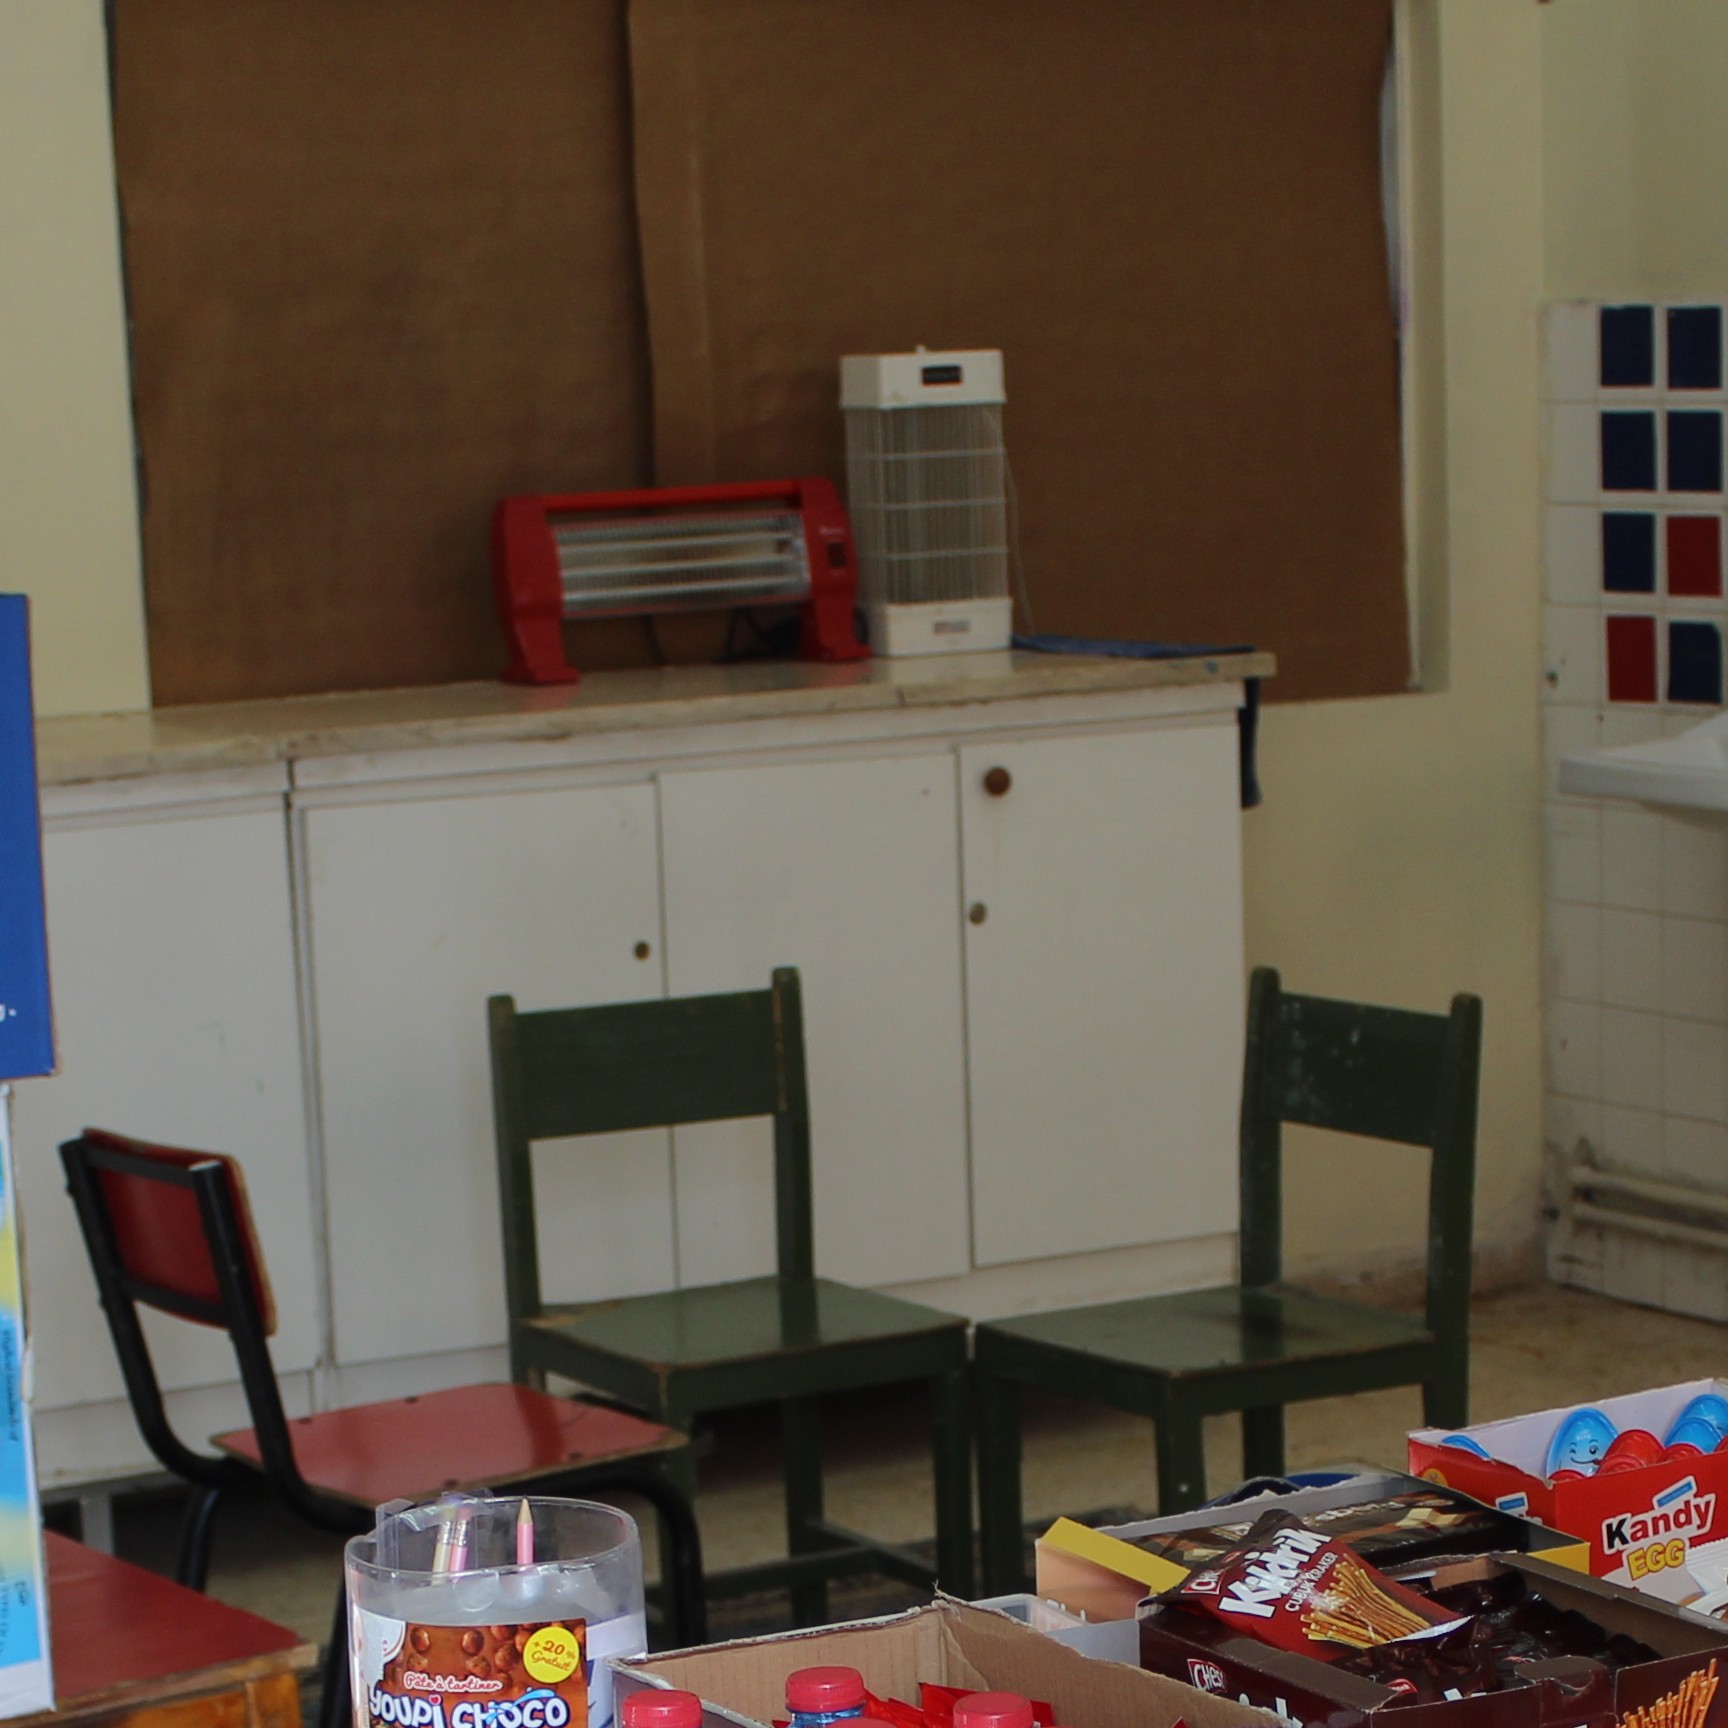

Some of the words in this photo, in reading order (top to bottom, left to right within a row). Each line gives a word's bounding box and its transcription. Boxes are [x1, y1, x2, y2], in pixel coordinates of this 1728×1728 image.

[1605, 1500, 1711, 1550] Kandy
[1626, 1539, 1685, 1581] EGG
[543, 1641, 565, 1655] 20
[531, 1652, 571, 1672] Gratuit
[405, 1673, 434, 1690] Pâte
[437, 1677, 445, 1690] à
[447, 1675, 501, 1691] tartiner
